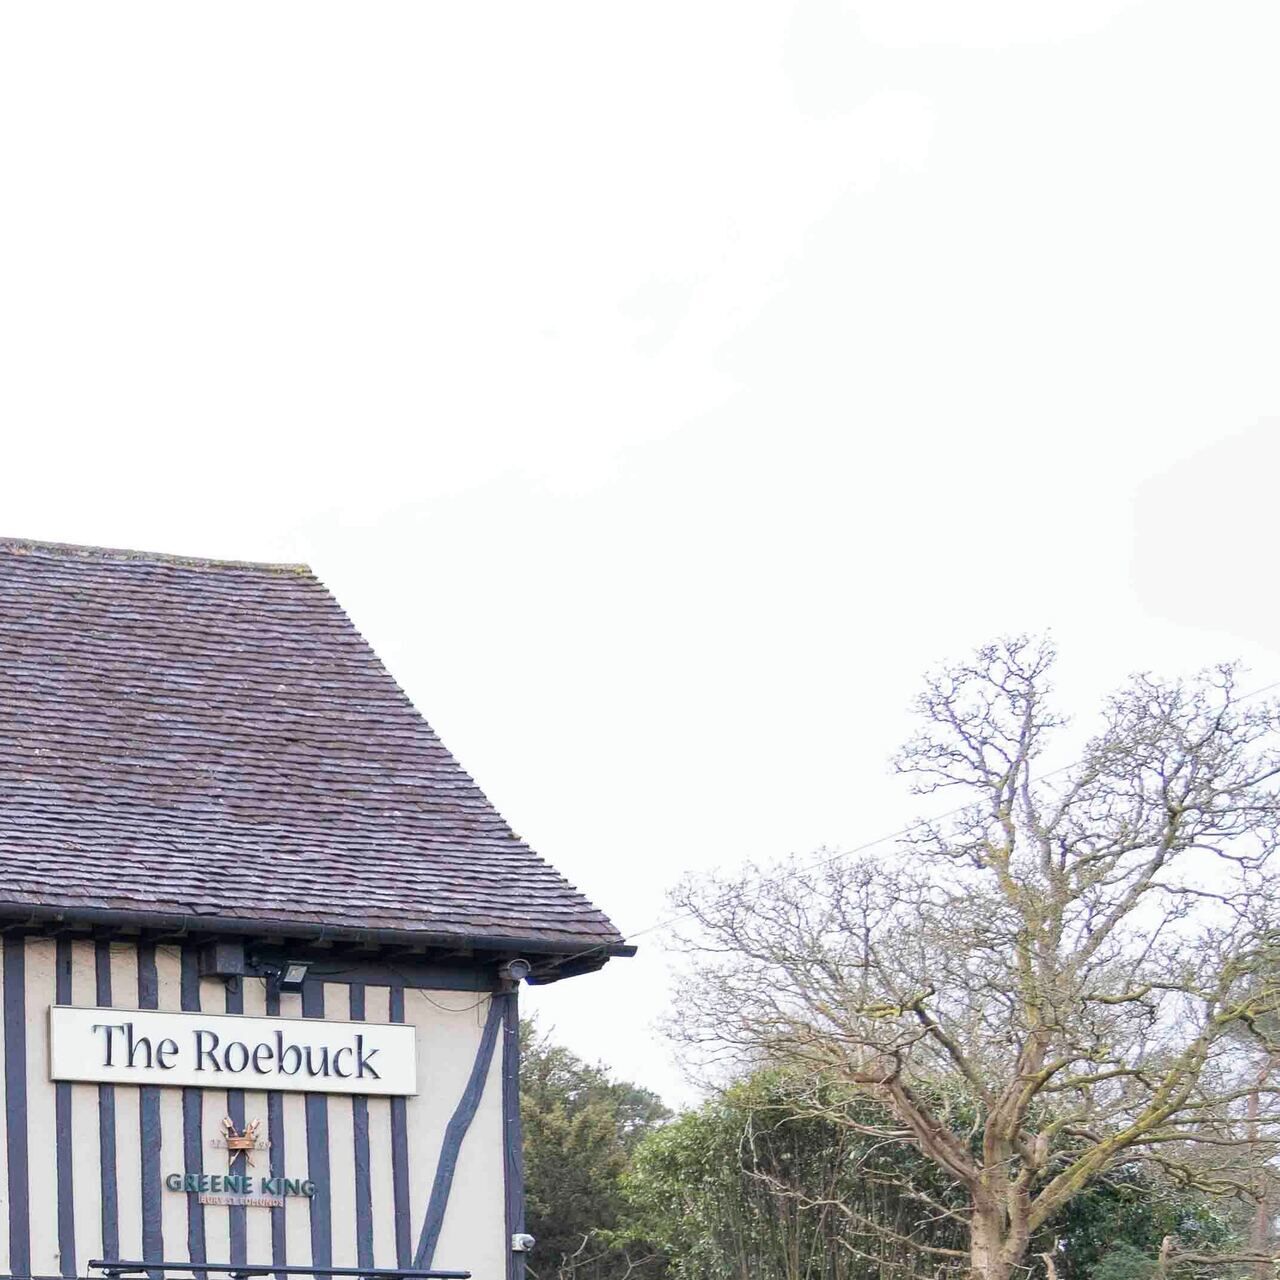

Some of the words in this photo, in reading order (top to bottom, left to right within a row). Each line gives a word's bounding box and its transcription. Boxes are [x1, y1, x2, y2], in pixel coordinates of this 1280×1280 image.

[93, 1022, 180, 1070] The
[192, 1029, 382, 1080] Roebuck
[165, 1173, 254, 1195] GREENE
[260, 1176, 316, 1198] KING
